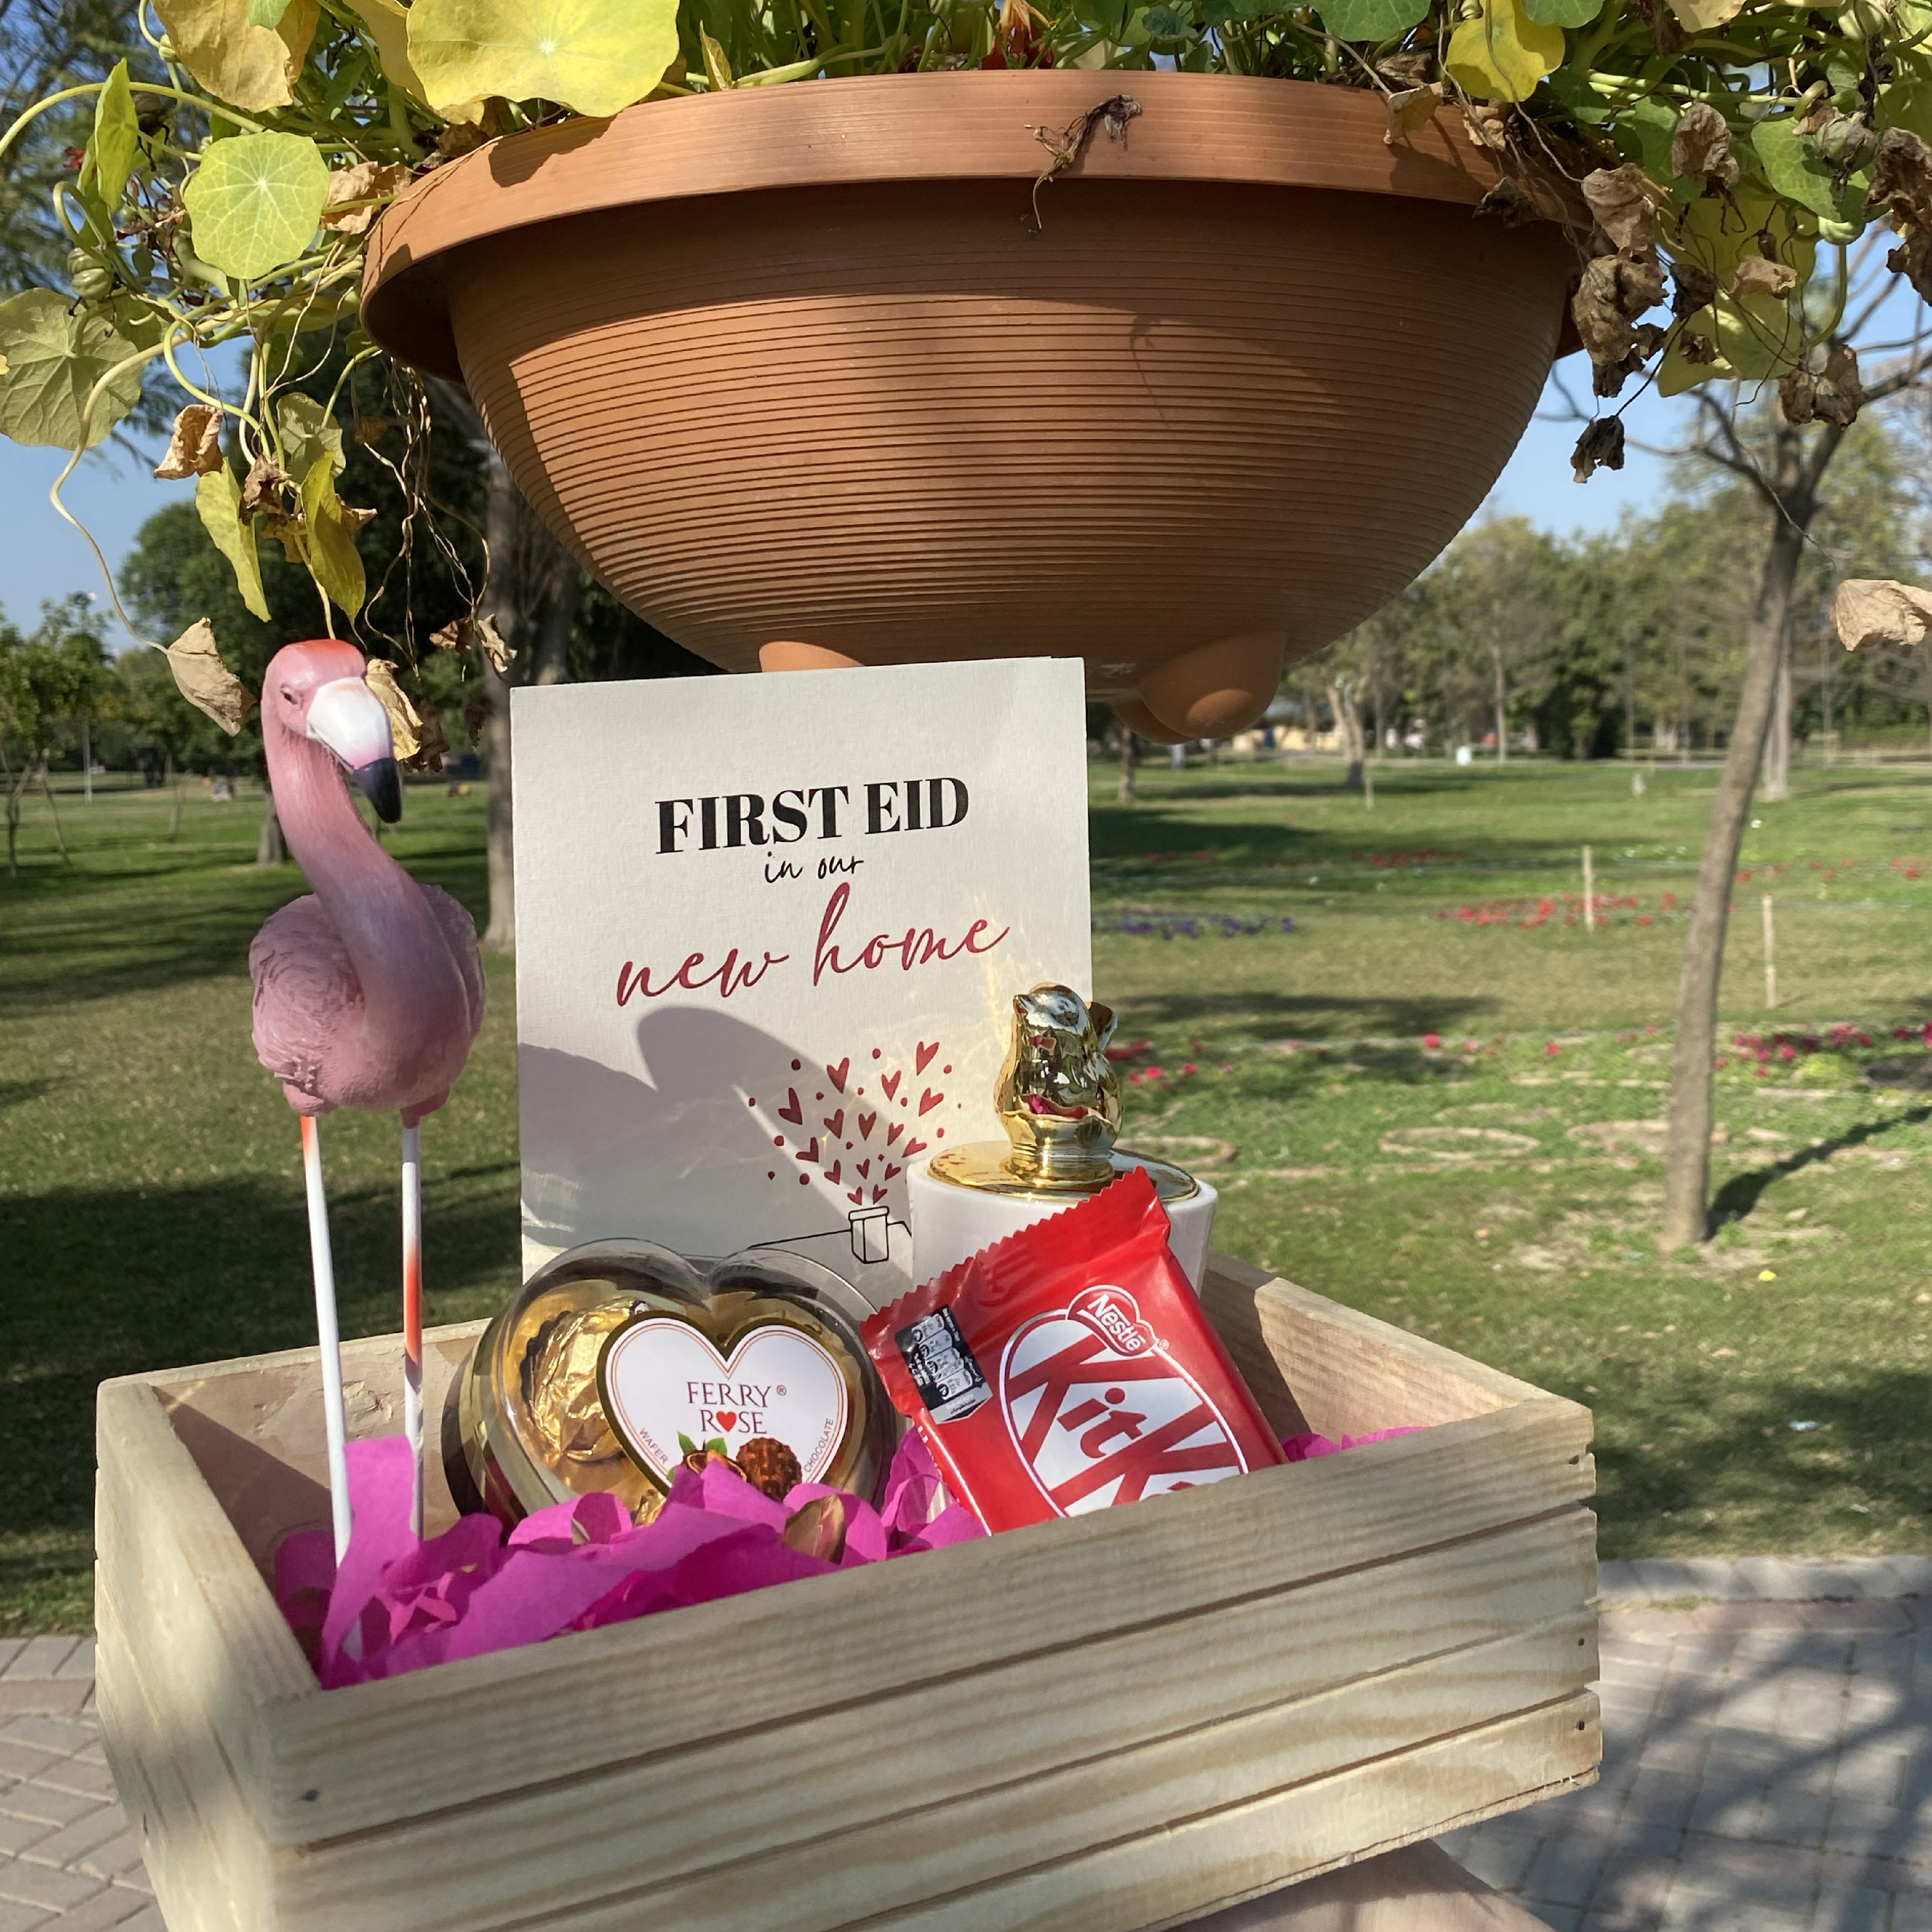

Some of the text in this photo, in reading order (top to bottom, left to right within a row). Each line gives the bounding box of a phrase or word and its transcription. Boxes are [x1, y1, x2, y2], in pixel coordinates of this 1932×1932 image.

[654, 777, 969, 855] FIRST EID
[764, 851, 865, 884] in our
[616, 881, 1011, 1006] new home
[640, 1428, 668, 1464] WAFER
[804, 1418, 834, 1473] CHOCOLATE
